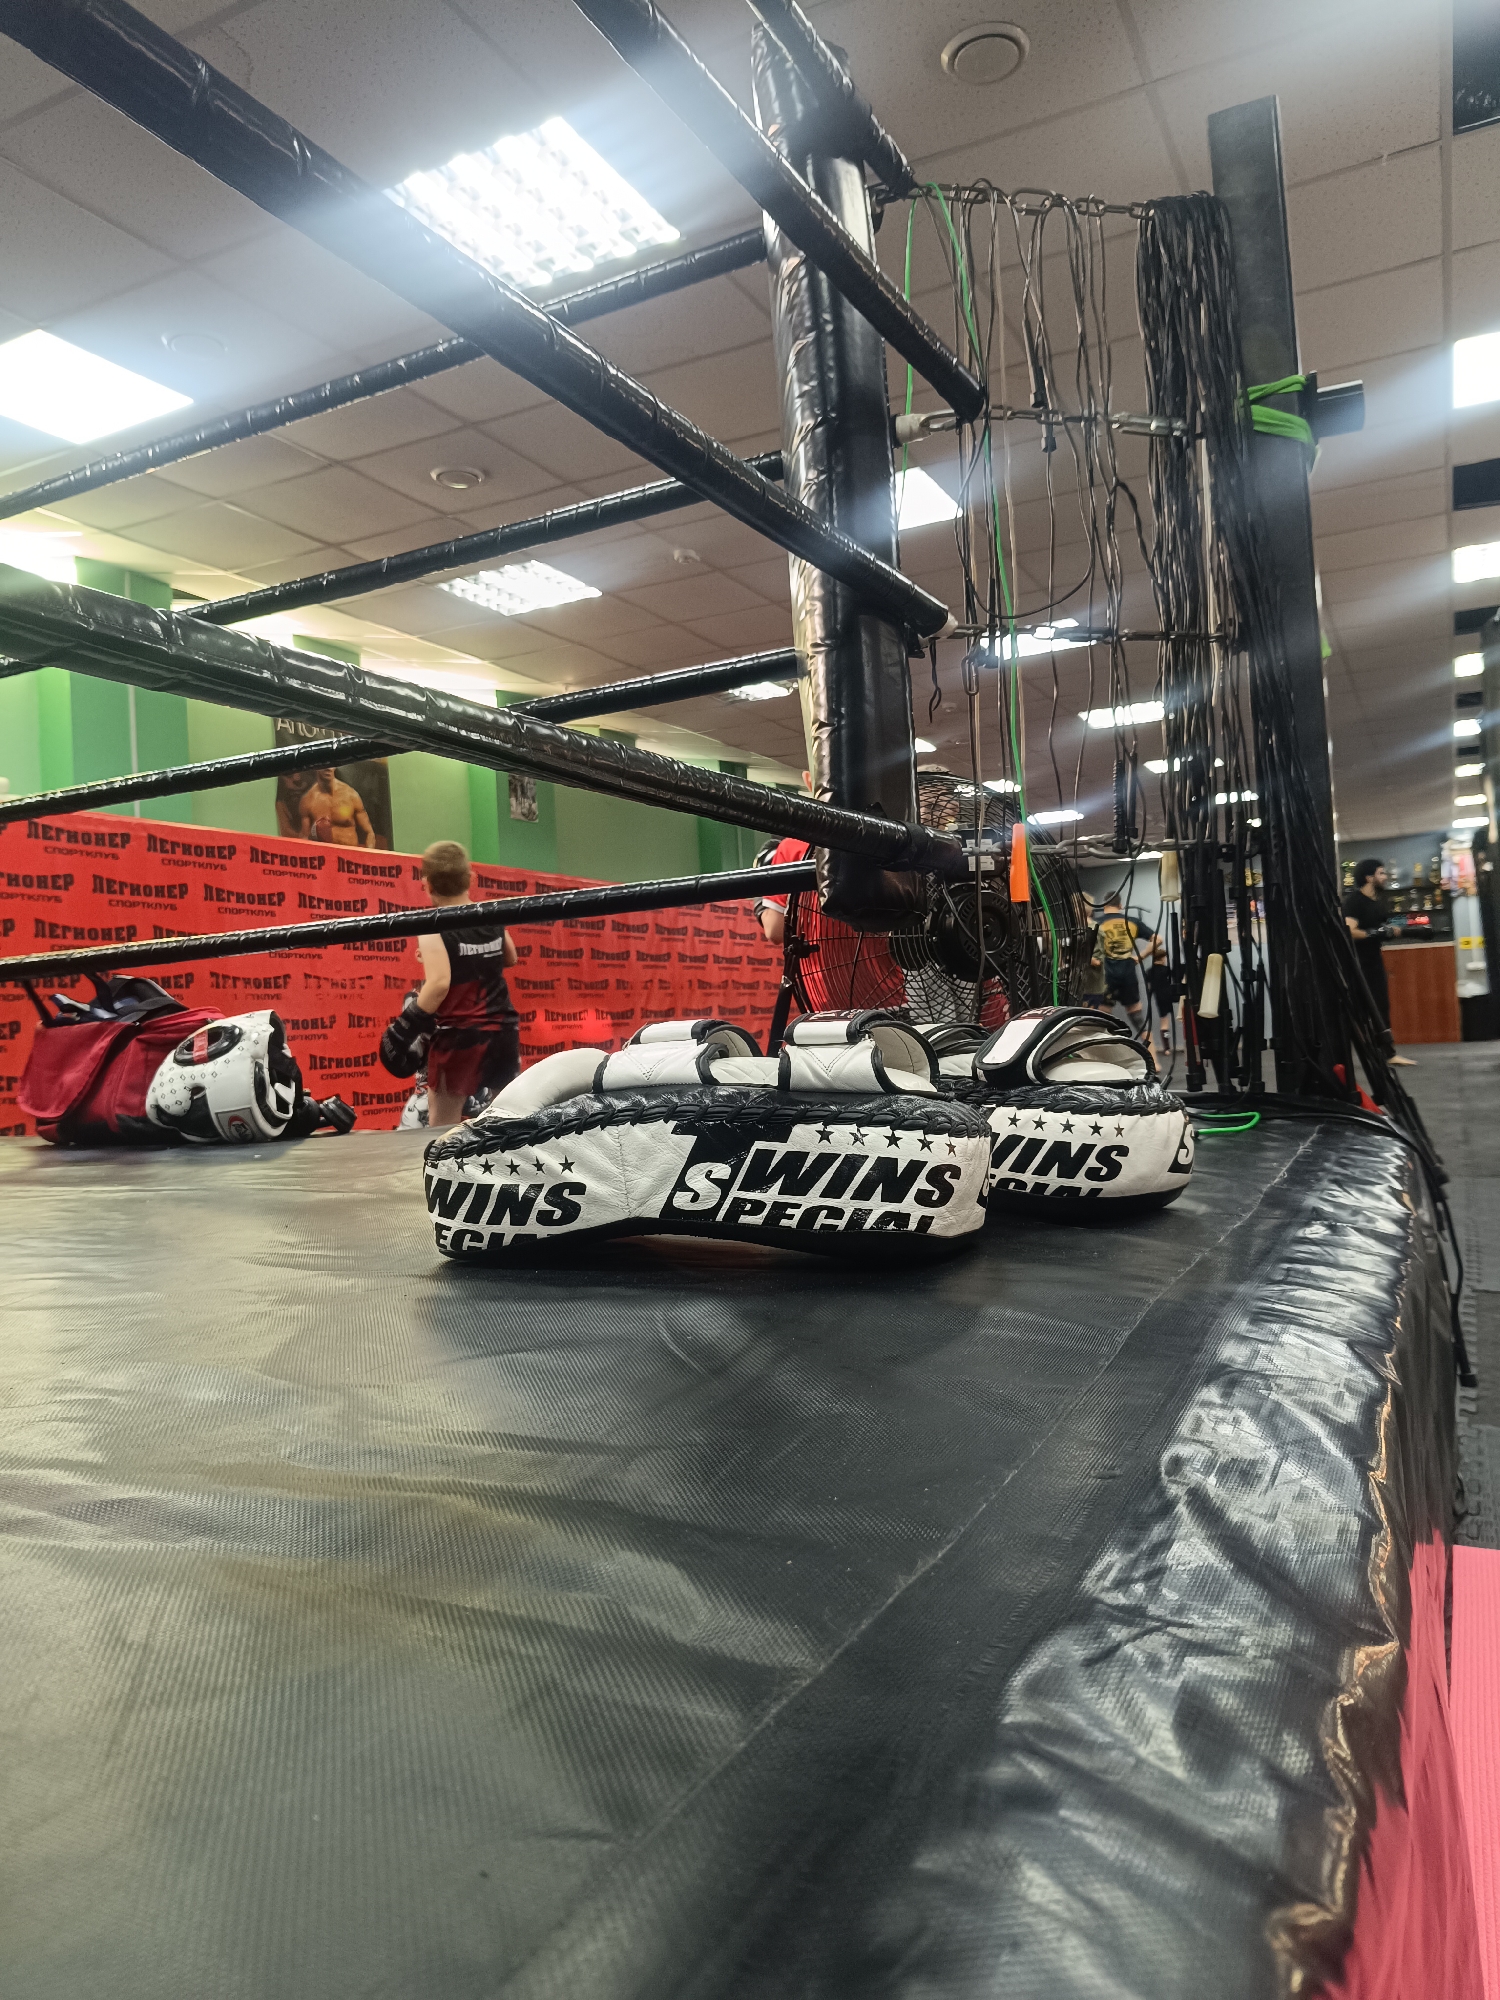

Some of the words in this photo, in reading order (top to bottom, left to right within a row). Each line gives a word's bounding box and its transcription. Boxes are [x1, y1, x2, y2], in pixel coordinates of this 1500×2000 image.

[27, 820, 131, 849] ЛЕГИОНЕР
[44, 846, 120, 861] СПОРТКЛУБ
[147, 834, 237, 861] ЛЕГИОНЕР
[161, 858, 228, 871] СПОРТКЛУБ
[250, 846, 326, 871] ЛЕГИОНЕР
[338, 856, 402, 878] ЛЕГИОНЕР
[263, 869, 317, 880] СПОРТКЛУБ
[348, 877, 396, 888] СПОРТКЛУБ
[92, 874, 189, 899] ЛЕГИОНЕР
[204, 884, 286, 906] ЛЕГИОНЕР
[108, 899, 177, 911] СПОРТКЛУБ
[218, 907, 276, 917] СПОРТКЛУБ
[298, 892, 368, 913] ЛЕГИОНЕР
[34, 918, 138, 942] ЛЕГИОНЕР
[309, 1052, 377, 1070] ЛЕГИОНЕР
